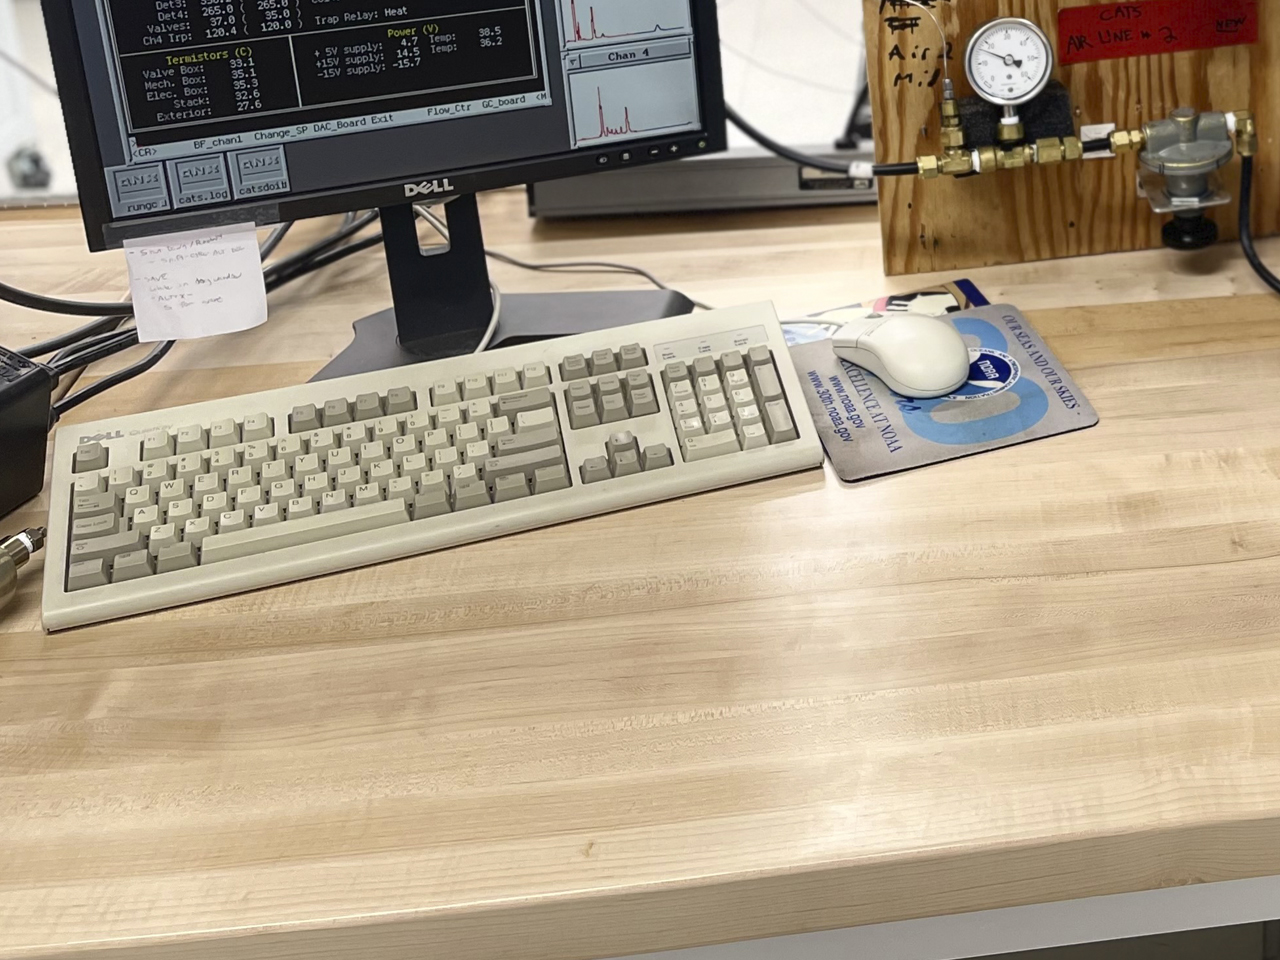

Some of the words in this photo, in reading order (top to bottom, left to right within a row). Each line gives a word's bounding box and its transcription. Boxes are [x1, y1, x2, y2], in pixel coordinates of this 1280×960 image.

[315, 14, 339, 26] Trap
[344, 10, 379, 23] Relay:
[384, 6, 408, 17] Heat
[1099, 5, 1142, 21] CATS
[387, 26, 417, 38] Power
[422, 23, 439, 35] (V)
[1066, 34, 1094, 55] AIR
[1098, 29, 1133, 44] LINE
[1158, 26, 1178, 43] 2
[1216, 16, 1247, 30] NEW
[165, 50, 229, 66] Termistors
[234, 46, 253, 59] (C)
[608, 50, 637, 61] Chan
[642, 48, 650, 58] 4
[193, 135, 243, 150] BF_chan1
[254, 125, 308, 141] Change_SP
[313, 118, 367, 133] DAC_Board
[371, 113, 394, 125] Exit
[427, 103, 472, 117] Flow_Ctr
[482, 95, 526, 109] GC_board
[178, 190, 229, 205] cats.log
[404, 178, 454, 198] DELL
[1002, 314, 1022, 333] OUR
[1016, 330, 1037, 350] SEAS
[1026, 347, 1049, 370] AND
[1041, 367, 1063, 386] OUR
[828, 374, 866, 429] www.noaa.gov
[1053, 384, 1081, 410] SKIES
[877, 424, 903, 453] NOAA
